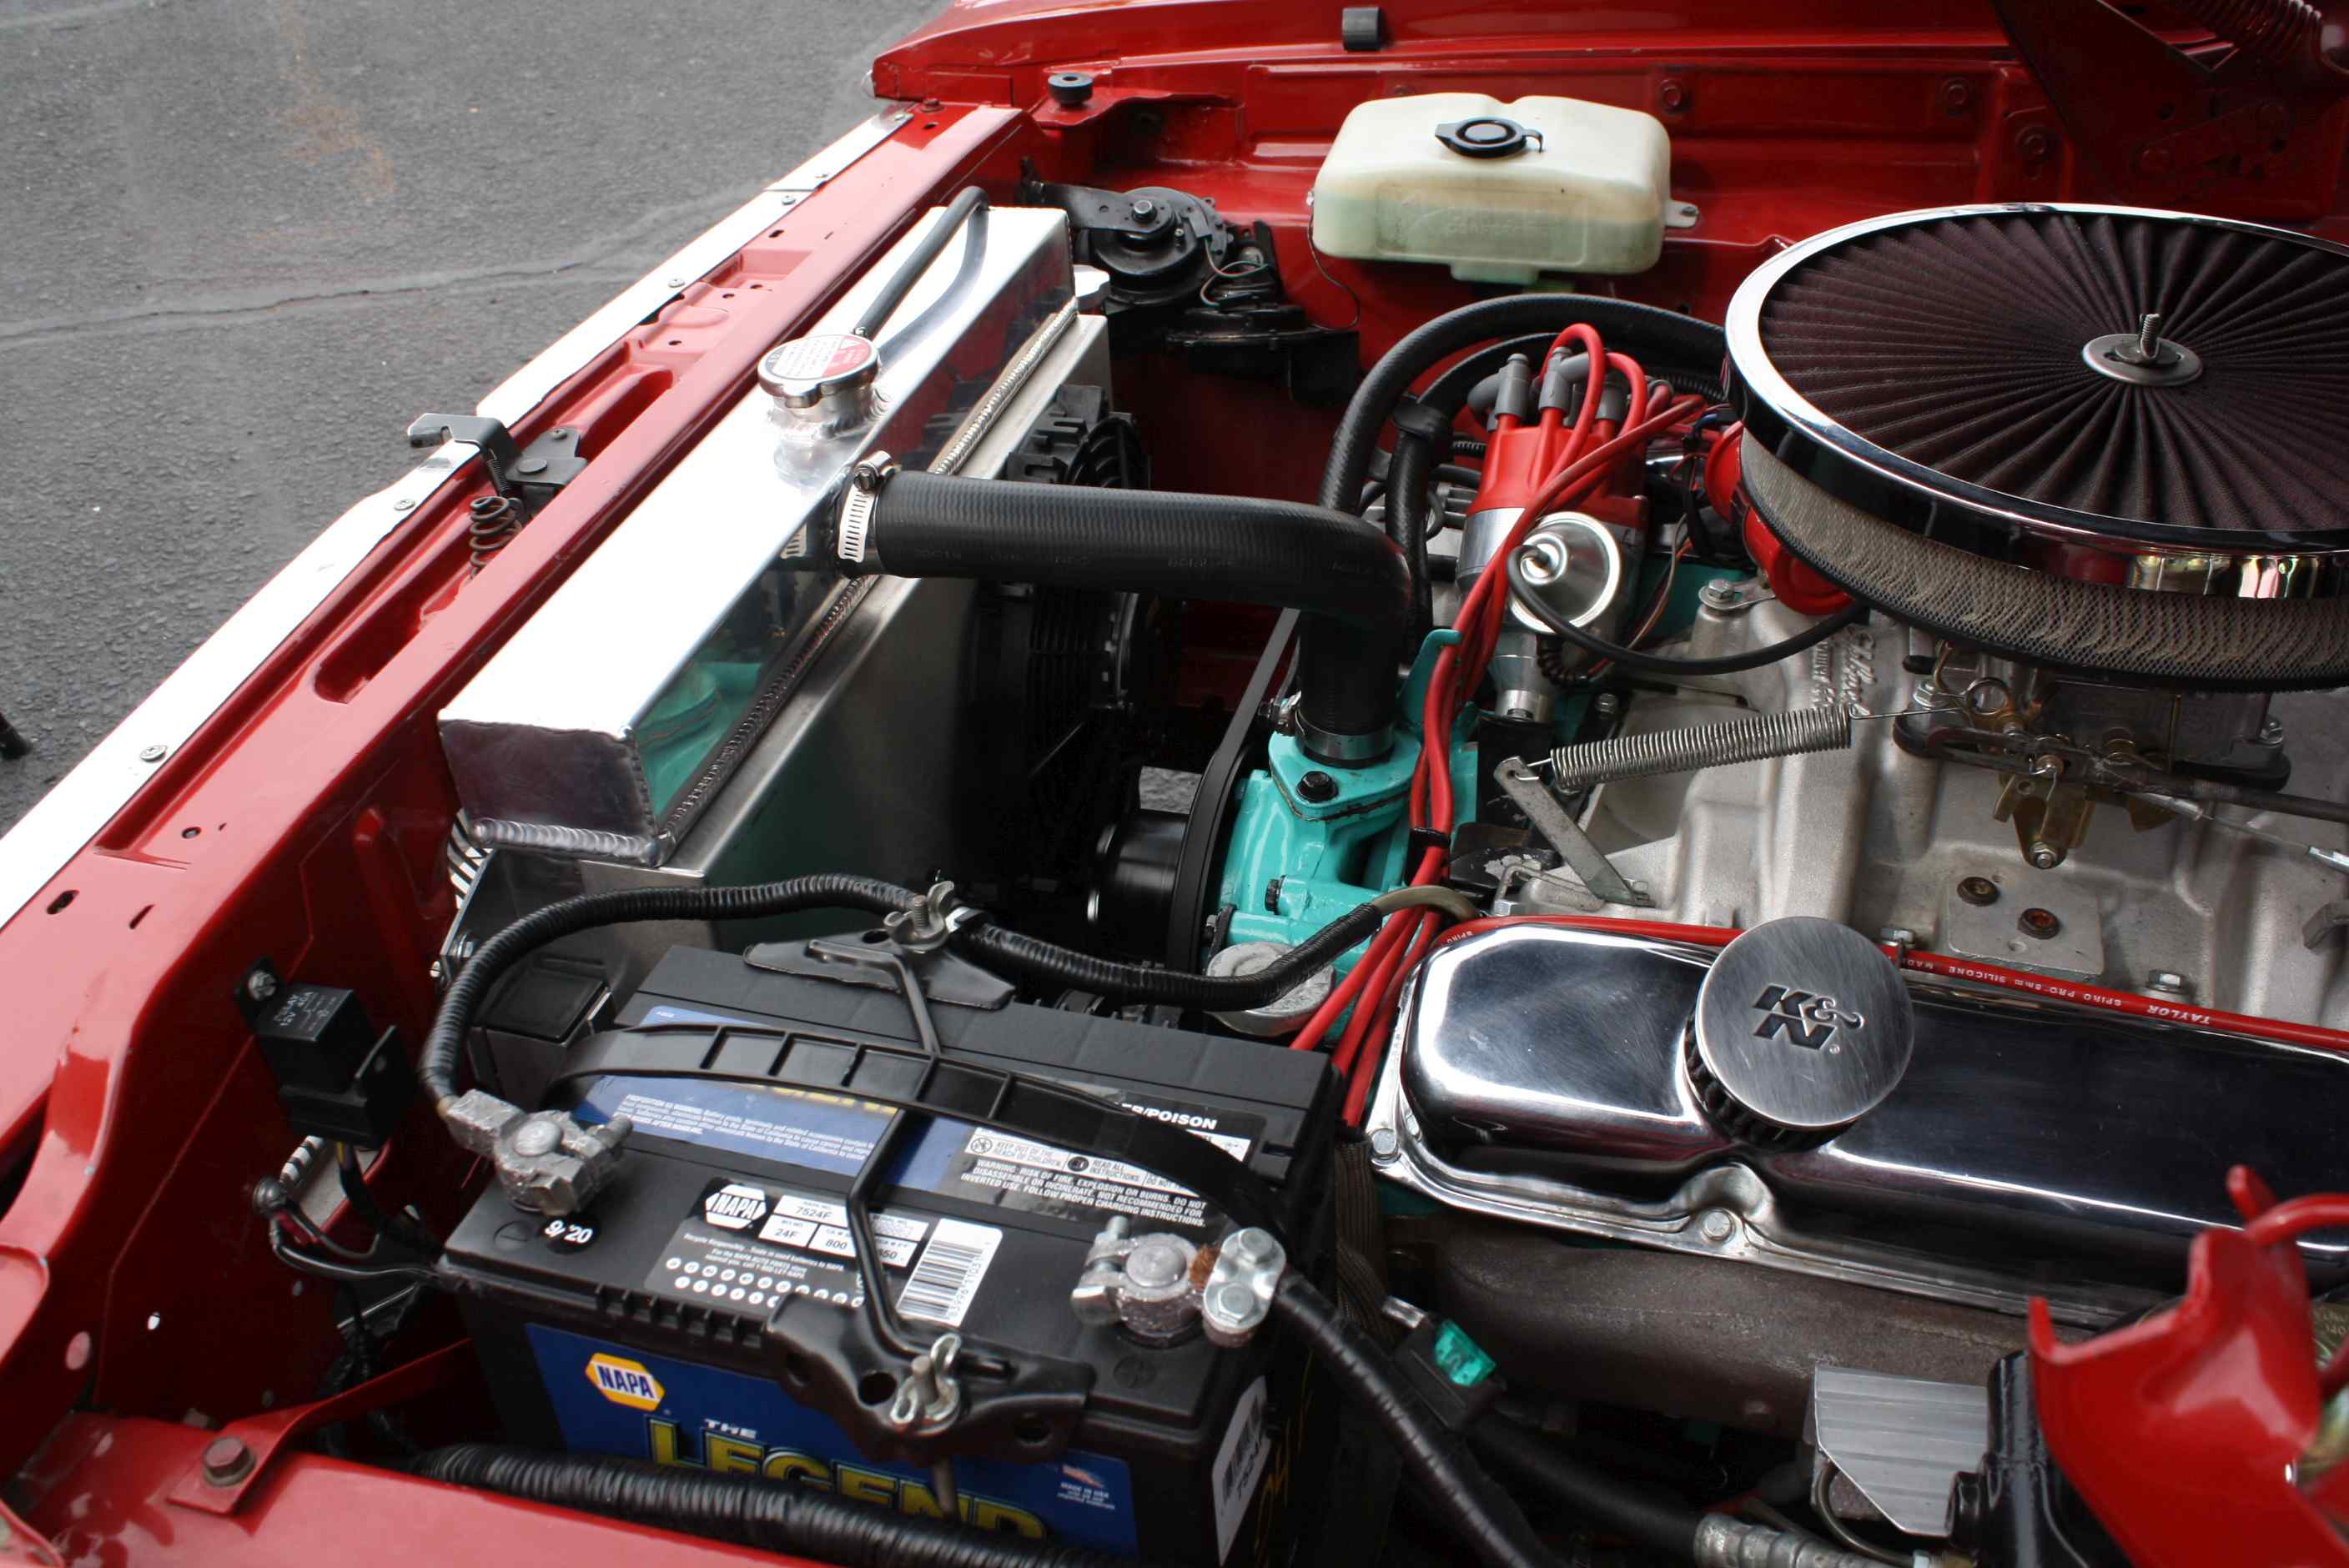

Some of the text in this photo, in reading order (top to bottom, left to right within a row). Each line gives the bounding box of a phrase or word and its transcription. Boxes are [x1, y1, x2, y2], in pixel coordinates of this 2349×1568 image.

[1904, 958, 1934, 970] MAD
[1948, 966, 2007, 983] SILICONE
[2083, 993, 2122, 1007] SPIRO
[1753, 983, 1865, 1051] K&N
[2147, 1004, 2210, 1024] TAYLOR
[1092, 1158, 1111, 1168] READ
[960, 1173, 1003, 1188] INVERTED
[1023, 1184, 1059, 1199] FOLLOW
[1059, 1192, 1094, 1206] PROPER
[1094, 1199, 1139, 1215] CHARGING
[973, 1167, 1029, 1184] DISASSEMBLE
[1031, 1177, 1044, 1187] OR
[1096, 1192, 1116, 1202] NOT
[1115, 1194, 1184, 1214] RECOMMENDED
[1184, 1206, 1203, 1218] FOR
[1019, 1166, 1041, 1177] RISK
[1040, 1170, 1054, 1179] OF
[1077, 1179, 1124, 1194] EXPLOSION
[1125, 1186, 1139, 1197] OR
[1173, 1196, 1188, 1206] DO
[1188, 1199, 1207, 1209] NOT
[713, 1194, 757, 1219] NAPA
[795, 1206, 833, 1220] 7524F
[775, 1228, 797, 1239] 24F
[825, 1239, 848, 1249] 800
[596, 1364, 655, 1399] NAPA
[704, 1418, 757, 1440] THE
